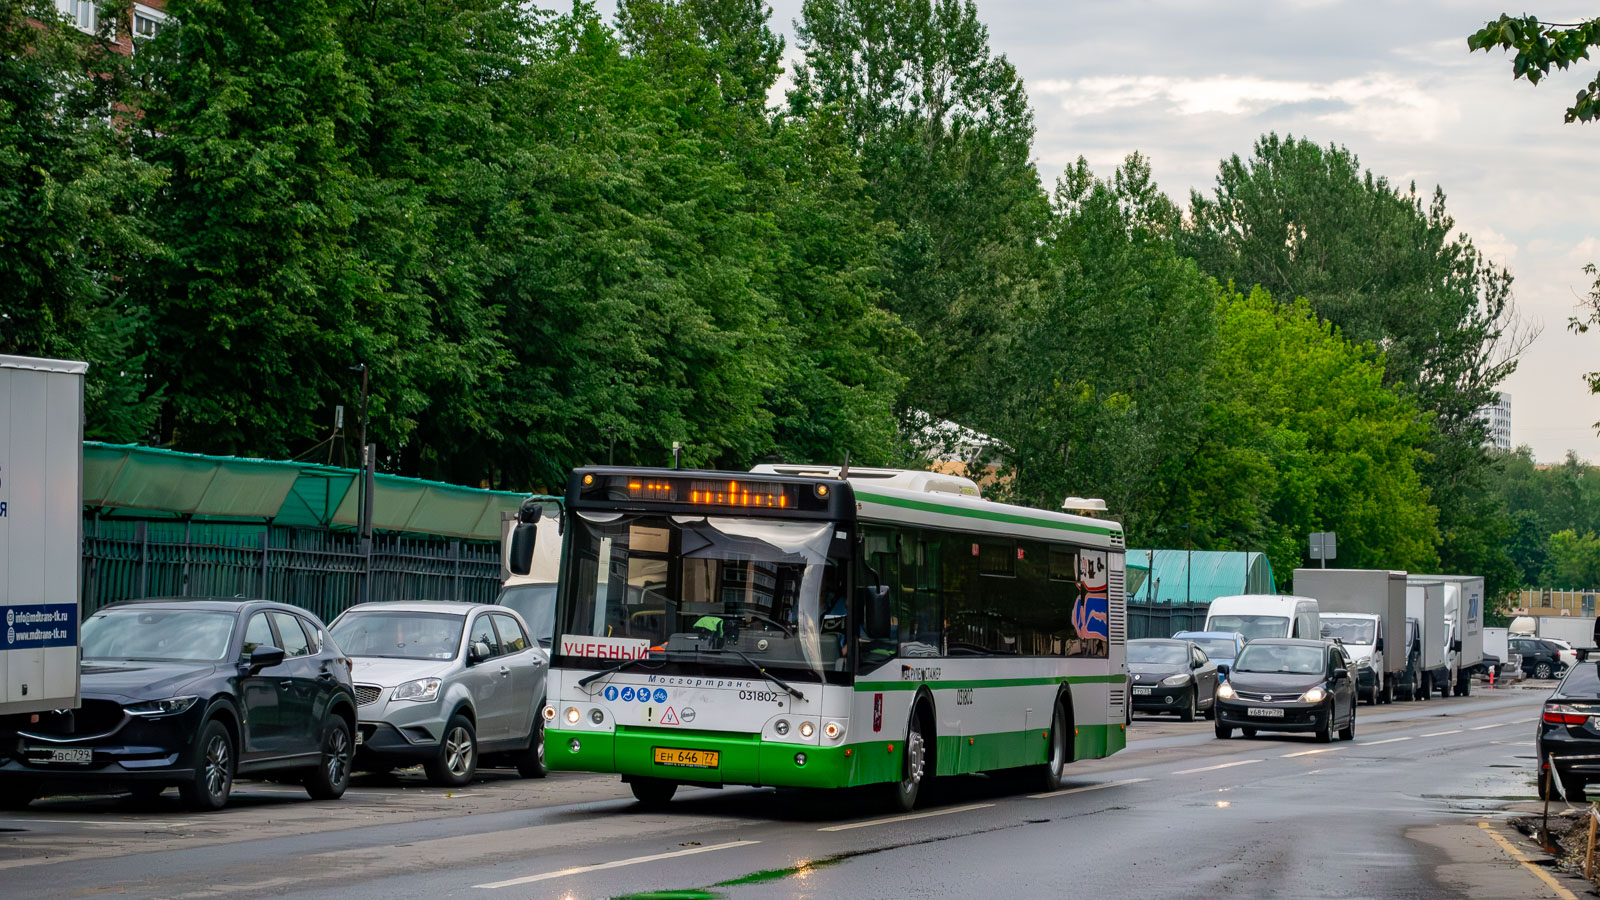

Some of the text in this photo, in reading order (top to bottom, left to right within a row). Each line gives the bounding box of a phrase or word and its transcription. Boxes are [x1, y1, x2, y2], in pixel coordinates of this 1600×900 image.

[15, 610, 68, 626] info@mdtrans-tk.ru
[15, 627, 67, 641] www.mdtrans-tk.ru
[564, 642, 648, 660] УЧЕБНЫЙ
[648, 675, 751, 688] Мосгортранс
[738, 690, 777, 702] 031802
[660, 751, 715, 763] ЕН 646 77
